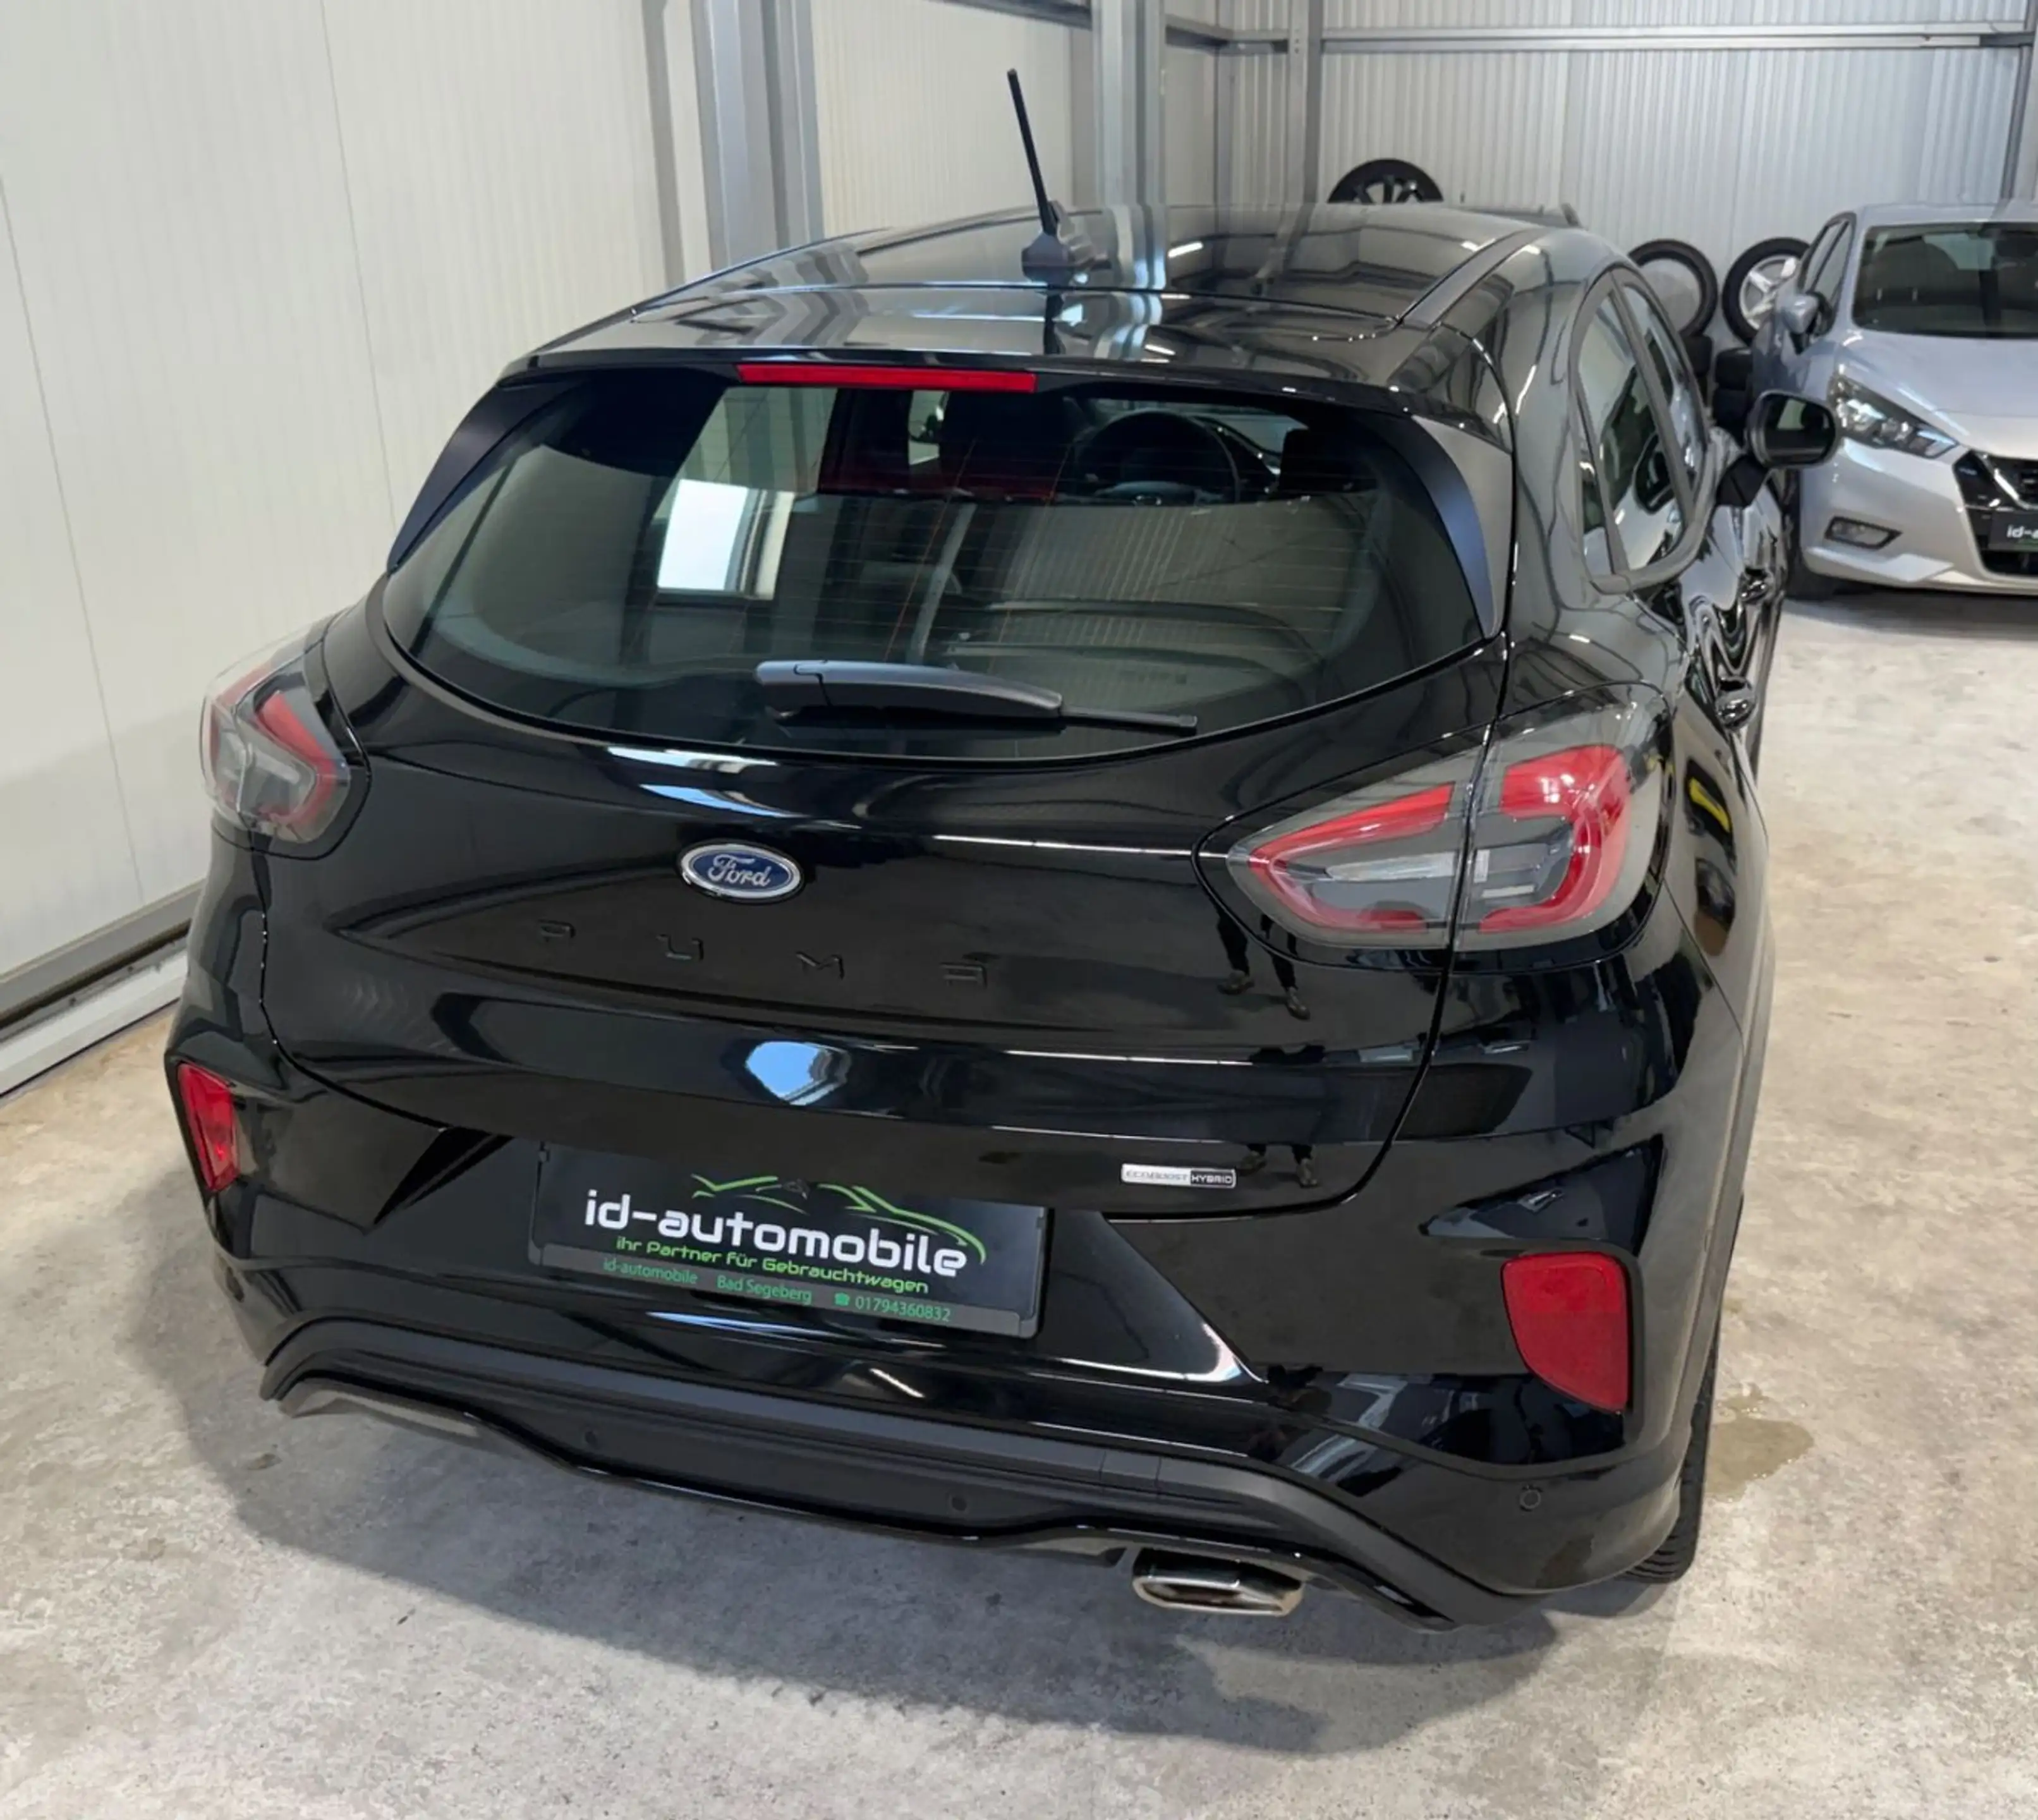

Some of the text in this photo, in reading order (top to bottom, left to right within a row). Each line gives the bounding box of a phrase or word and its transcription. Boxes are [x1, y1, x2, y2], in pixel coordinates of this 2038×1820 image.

[707, 854, 772, 887] Ford
[1191, 1173, 1233, 1185] HYBRID
[585, 1189, 967, 1277] id-automobile
[602, 1256, 952, 1323] id-automobile Bad Segeberg 01794360832
[646, 1240, 722, 1263] Partner
[726, 1251, 758, 1268] für
[762, 1256, 929, 1294] Gebrauchtwagen
